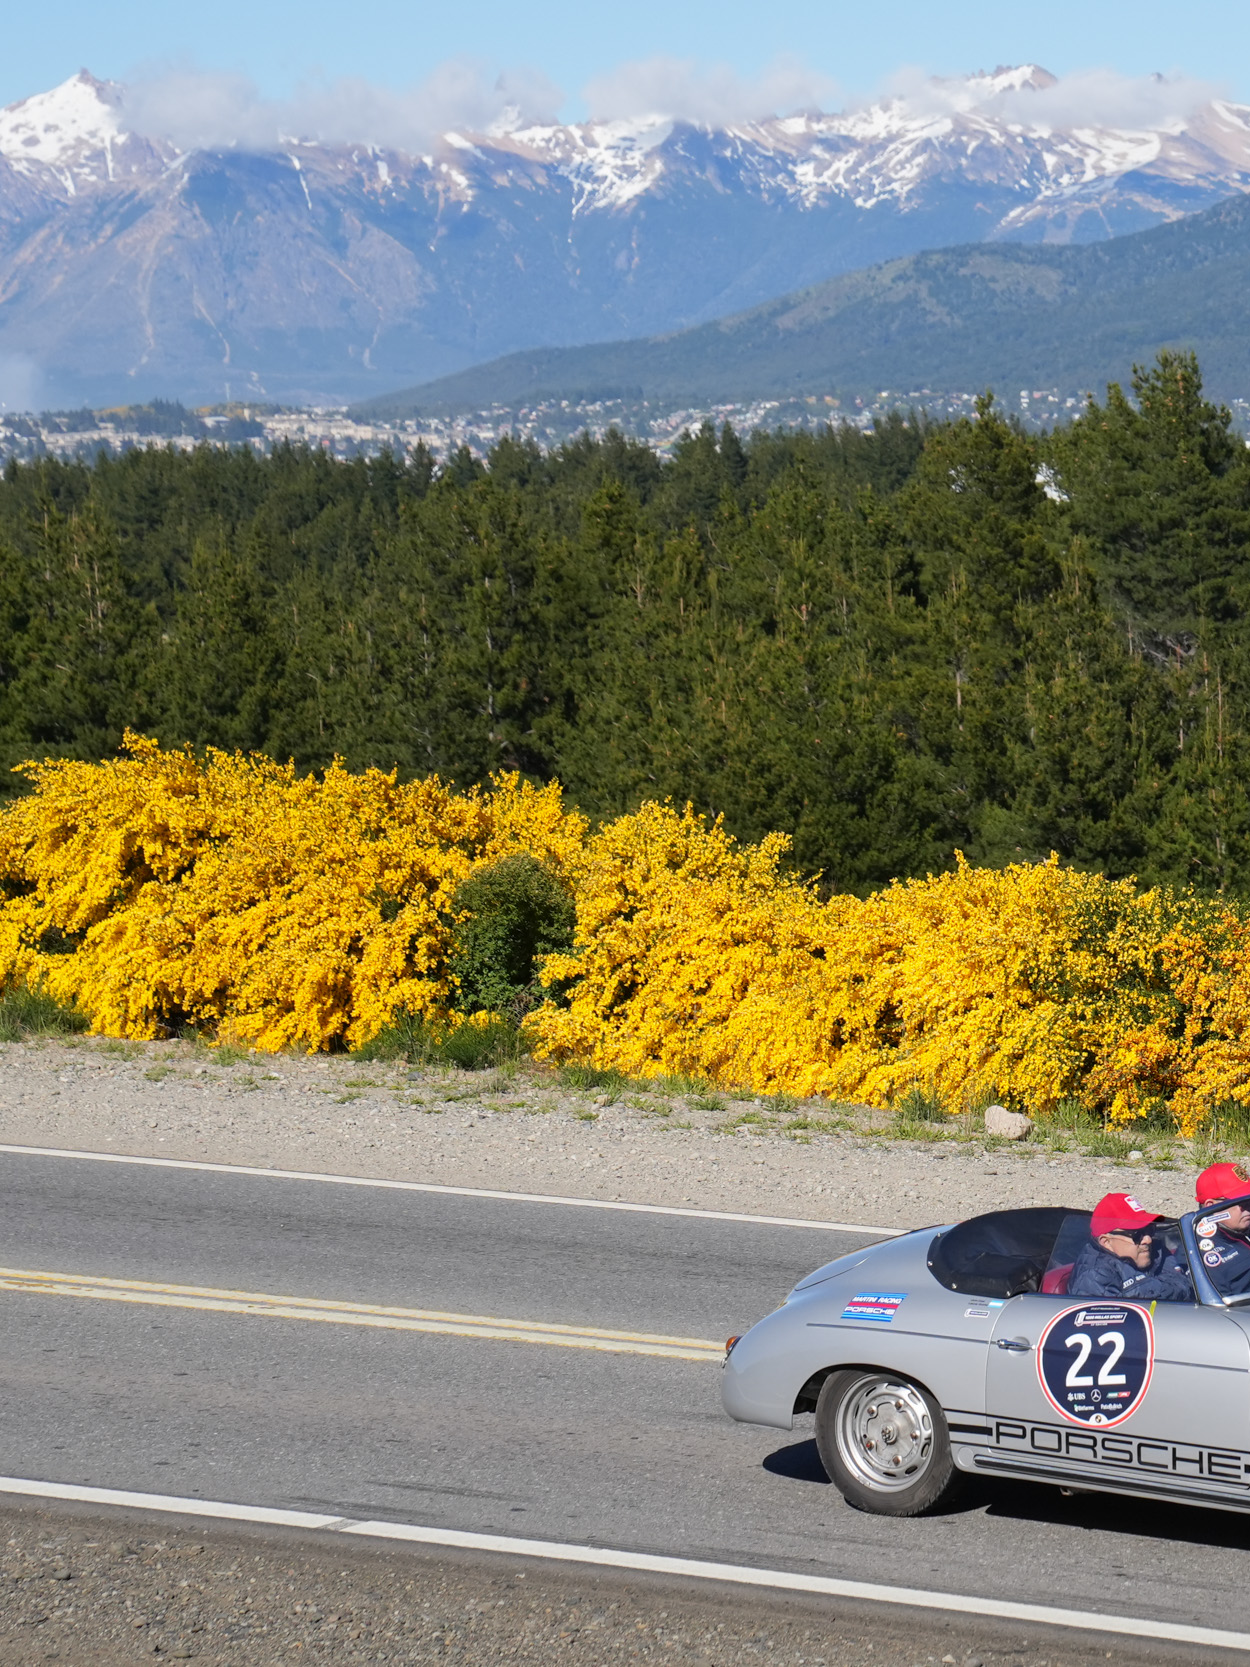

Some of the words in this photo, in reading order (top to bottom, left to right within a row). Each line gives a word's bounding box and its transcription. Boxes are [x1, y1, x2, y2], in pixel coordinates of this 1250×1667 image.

[878, 1296, 903, 1304] RACING
[844, 1306, 896, 1315] PORSCHE
[1065, 1331, 1126, 1387] 22
[1074, 1392, 1086, 1401] UBS
[995, 1421, 1241, 1479] PORSCHE
